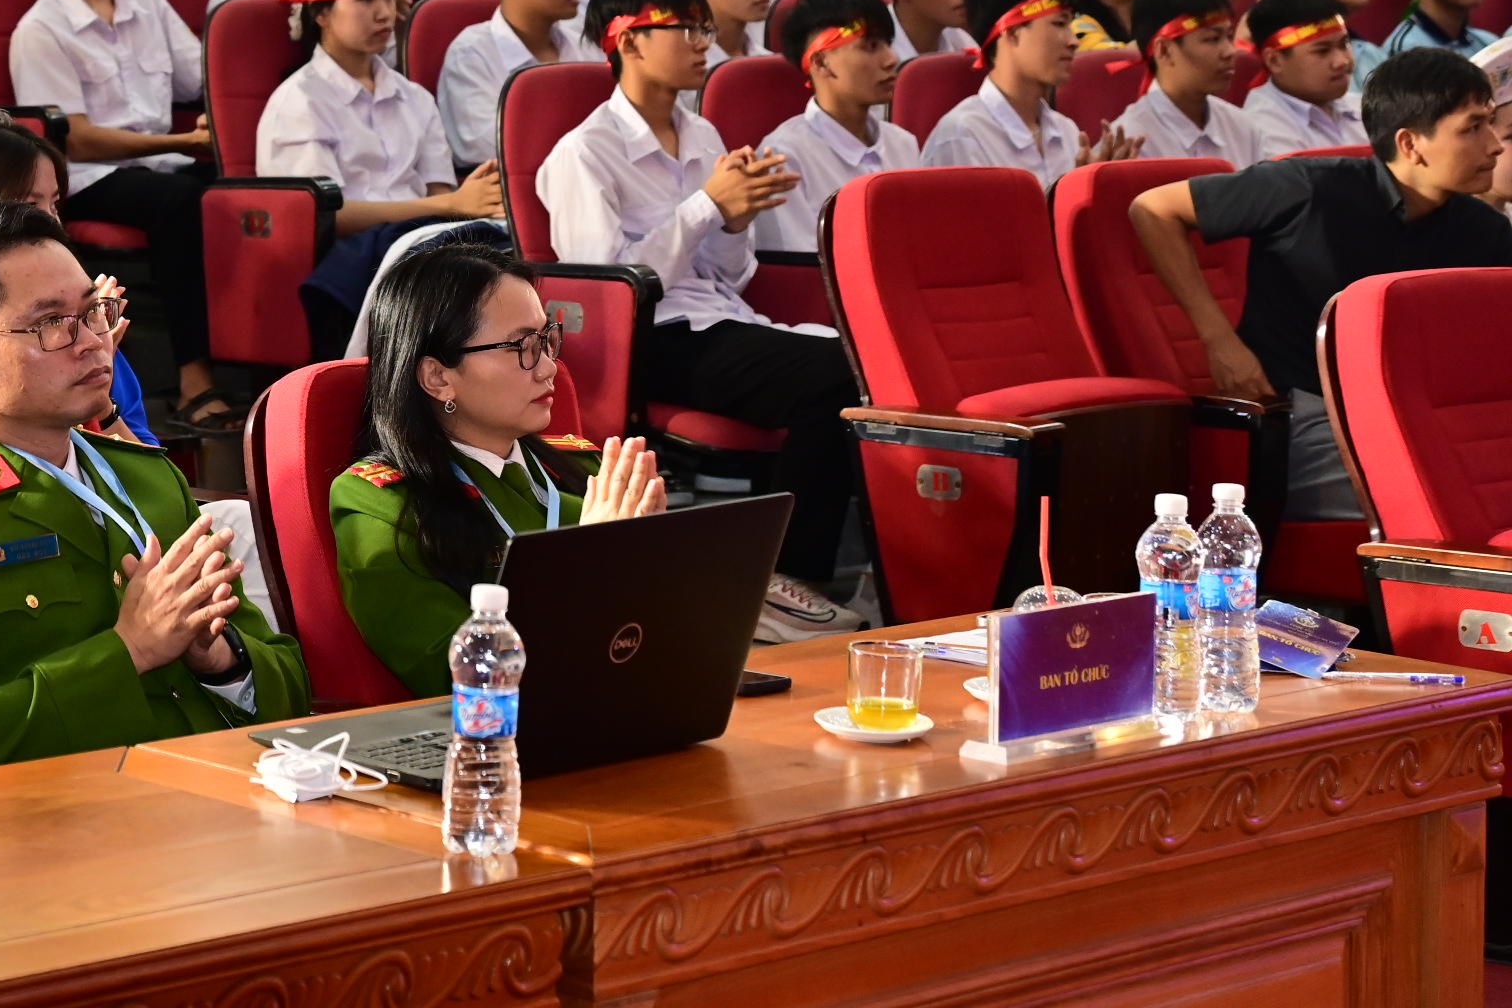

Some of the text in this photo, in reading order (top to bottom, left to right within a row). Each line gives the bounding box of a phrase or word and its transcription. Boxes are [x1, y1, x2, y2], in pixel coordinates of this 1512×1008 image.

[933, 471, 951, 492] B
[614, 637, 637, 651] DELL
[1475, 622, 1497, 645] A
[1039, 664, 1110, 690] BAN TỔ CHỨC
